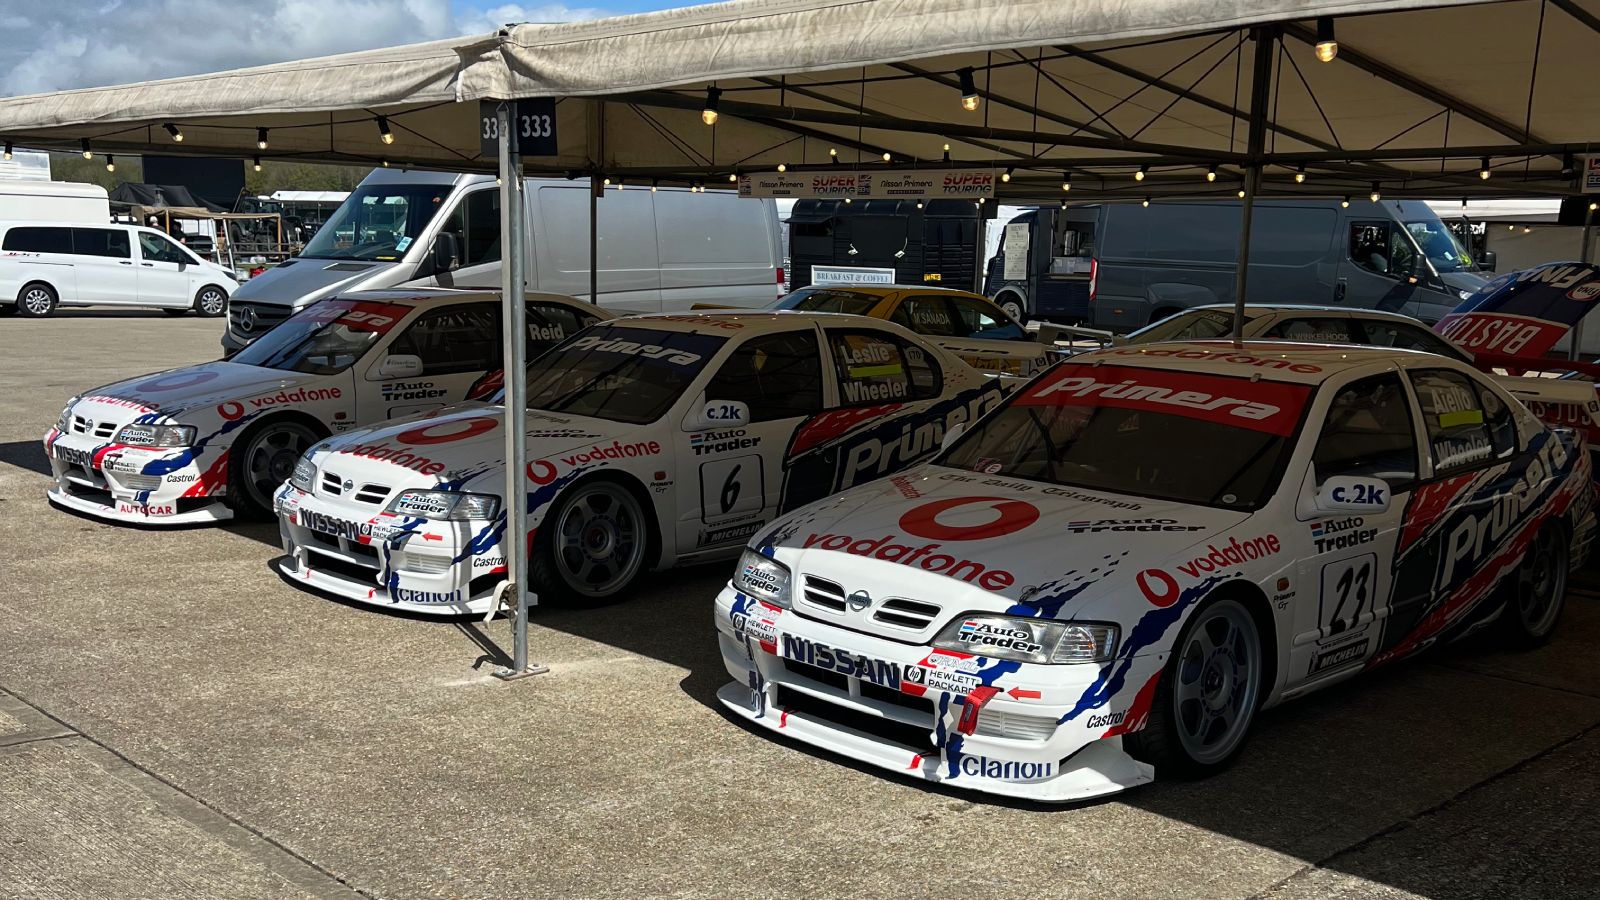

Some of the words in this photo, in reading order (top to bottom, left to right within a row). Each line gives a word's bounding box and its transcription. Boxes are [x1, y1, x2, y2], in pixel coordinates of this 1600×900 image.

[522, 115, 551, 138] 333
[812, 175, 855, 186] SUPER
[943, 173, 993, 185] SUPER
[812, 186, 855, 194] TOURING
[943, 185, 992, 194] TOURING
[816, 272, 854, 281] BREAKFAST
[855, 274, 861, 282] &
[863, 275, 889, 283] COFFEE
[529, 323, 564, 341] Reid
[559, 336, 702, 366] Primera
[841, 345, 890, 364] Leslie
[382, 389, 447, 401] Trader
[393, 382, 434, 391] Auto
[842, 380, 909, 403] Wheeler
[249, 387, 342, 407] vodafone
[1033, 377, 1281, 420] Primera
[706, 404, 742, 420] c.2k
[120, 435, 155, 444] Trader
[125, 430, 151, 438] Auto
[703, 429, 746, 442] Auto
[561, 439, 661, 467] vodafone
[692, 436, 761, 456] Trader
[54, 444, 92, 469] NISSAN
[166, 474, 196, 483] Castrol
[720, 464, 743, 514] 6
[1332, 484, 1385, 505] c.2k
[399, 501, 446, 513] Trader
[410, 495, 439, 505] Auto
[120, 504, 173, 515] AUTOCAR
[300, 507, 360, 540] NISSAN
[1067, 525, 1206, 534] Trader
[1092, 518, 1178, 526] Auto
[1324, 517, 1364, 534] Auto
[1314, 528, 1378, 554] Trader
[473, 555, 507, 568] Castrol
[801, 533, 1016, 591] vodafone
[1176, 533, 1281, 578] vodafone
[742, 573, 780, 594] Trader
[752, 568, 776, 582] Auto
[1330, 562, 1371, 636] 23
[747, 619, 776, 633] HEWLETT
[977, 623, 1028, 640] Auto
[746, 627, 775, 643] PACKARD
[958, 631, 1042, 654] Trader
[782, 632, 901, 691] NISSAN
[1319, 642, 1369, 669] MICHELIN
[930, 670, 977, 686] HEWLETT
[1087, 709, 1126, 729] Castrol
